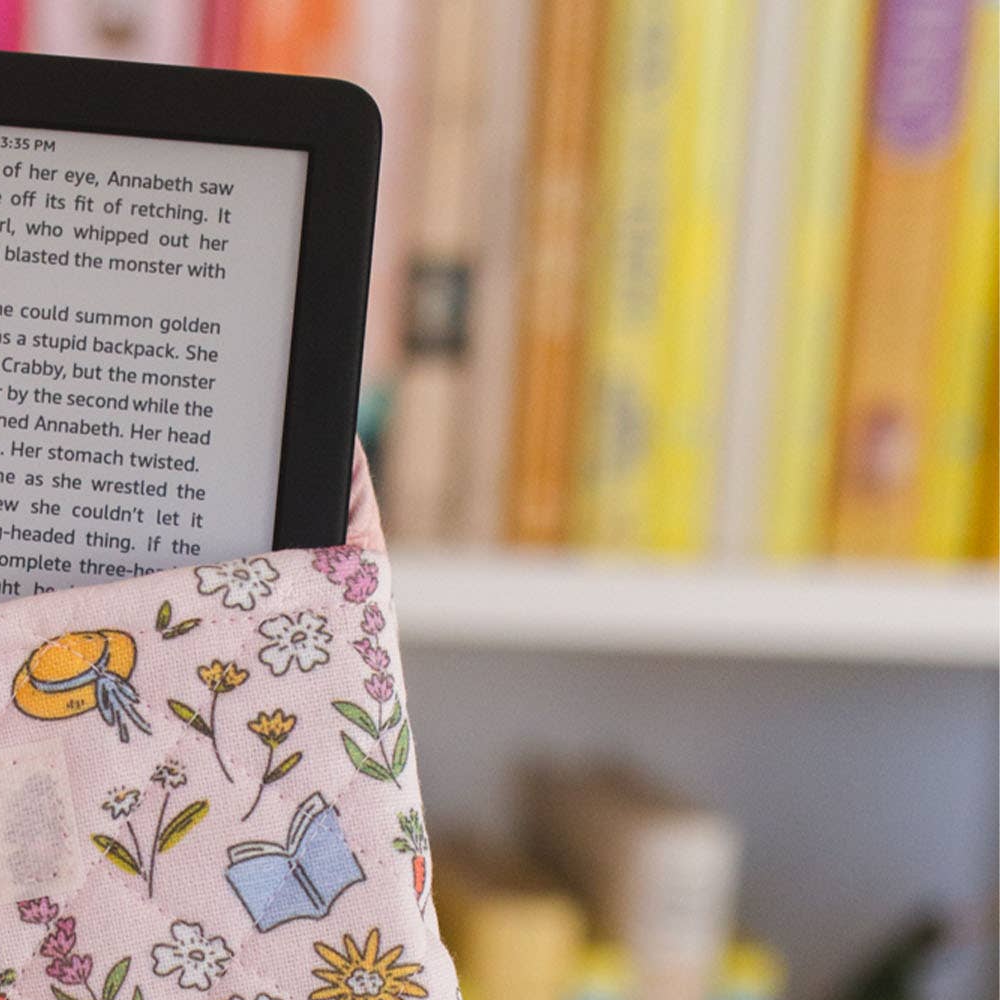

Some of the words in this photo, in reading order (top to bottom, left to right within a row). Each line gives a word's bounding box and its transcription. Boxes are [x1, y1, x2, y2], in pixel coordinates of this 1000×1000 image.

[0, 136, 30, 150] 3:35
[34, 139, 56, 152] PM
[2, 161, 23, 178] of
[29, 163, 58, 181] her
[64, 170, 99, 188] eye,
[107, 170, 193, 193] Annabeth
[199, 182, 234, 196] saw
[10, 190, 37, 208] off
[45, 193, 66, 210] its
[74, 194, 94, 213] fit
[103, 198, 123, 215] of
[130, 202, 208, 226] retching.
[218, 207, 232, 224] It
[25, 220, 63, 238] who
[73, 224, 149, 247] whipped
[159, 233, 190, 249] out
[199, 233, 229, 252] her
[4, 245, 70, 266] blasted
[74, 252, 103, 269] the
[108, 258, 183, 276] monster
[187, 262, 226, 280] with
[20, 304, 69, 322] could
[75, 310, 153, 329] summon
[160, 316, 221, 335] golden
[16, 334, 27, 346] a
[32, 333, 87, 353] stupid
[92, 336, 179, 360] backpack.
[185, 344, 218, 363] She
[1, 356, 67, 381] Crabby,
[72, 362, 103, 381] but
[107, 365, 137, 384] the
[141, 372, 216, 390] monster
[7, 384, 29, 406] by
[33, 387, 63, 405] the
[66, 393, 129, 411] second
[132, 397, 180, 415] while
[184, 400, 213, 418] the
[34, 415, 124, 438] Annabeth.
[130, 423, 163, 441] Her
[167, 426, 211, 446] head
[10, 440, 43, 459] Her
[47, 445, 124, 466] stomach
[129, 452, 199, 472] twisted.
[24, 473, 44, 487] as
[52, 472, 82, 490] she
[91, 479, 168, 498] wrestled
[176, 483, 206, 501] the
[30, 498, 61, 516] she
[156, 508, 180, 527] let
[191, 512, 203, 529] it
[85, 531, 135, 554] thing.
[147, 535, 161, 552] If
[171, 538, 202, 556] the
